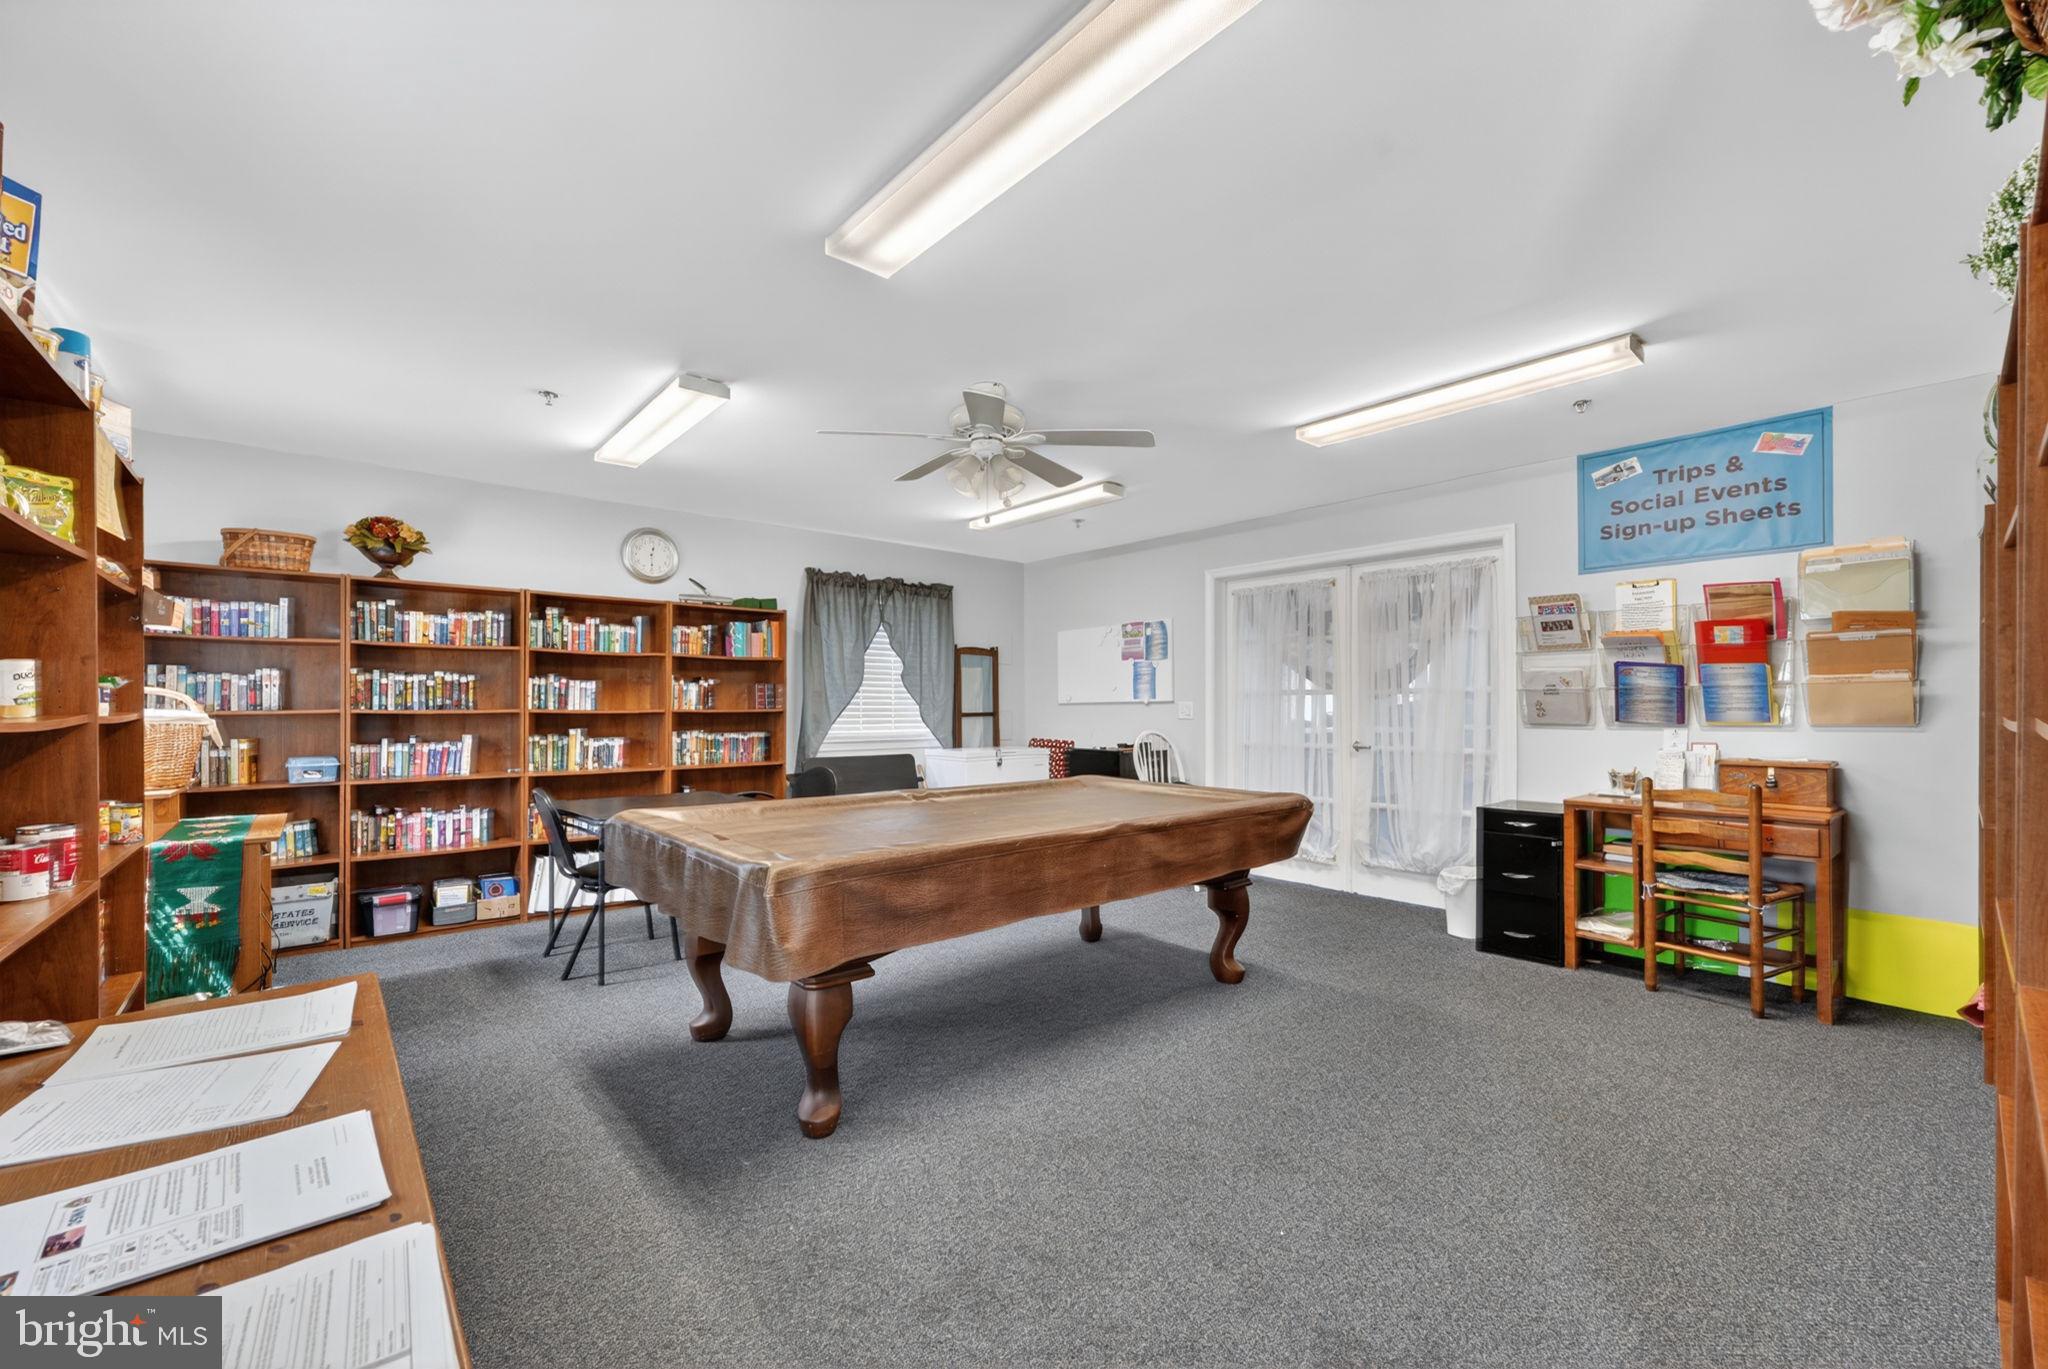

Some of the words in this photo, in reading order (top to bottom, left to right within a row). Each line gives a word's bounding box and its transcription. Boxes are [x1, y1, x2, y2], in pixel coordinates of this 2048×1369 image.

[1652, 461, 1716, 485] Trips
[1726, 455, 1744, 473] &
[1610, 490, 1684, 516] Social
[1694, 476, 1788, 504] Events
[1599, 515, 1696, 541] Sign-up
[1704, 501, 1802, 527] Sheets
[272, 908, 315, 920] STATES
[272, 917, 319, 930] SERVICE
